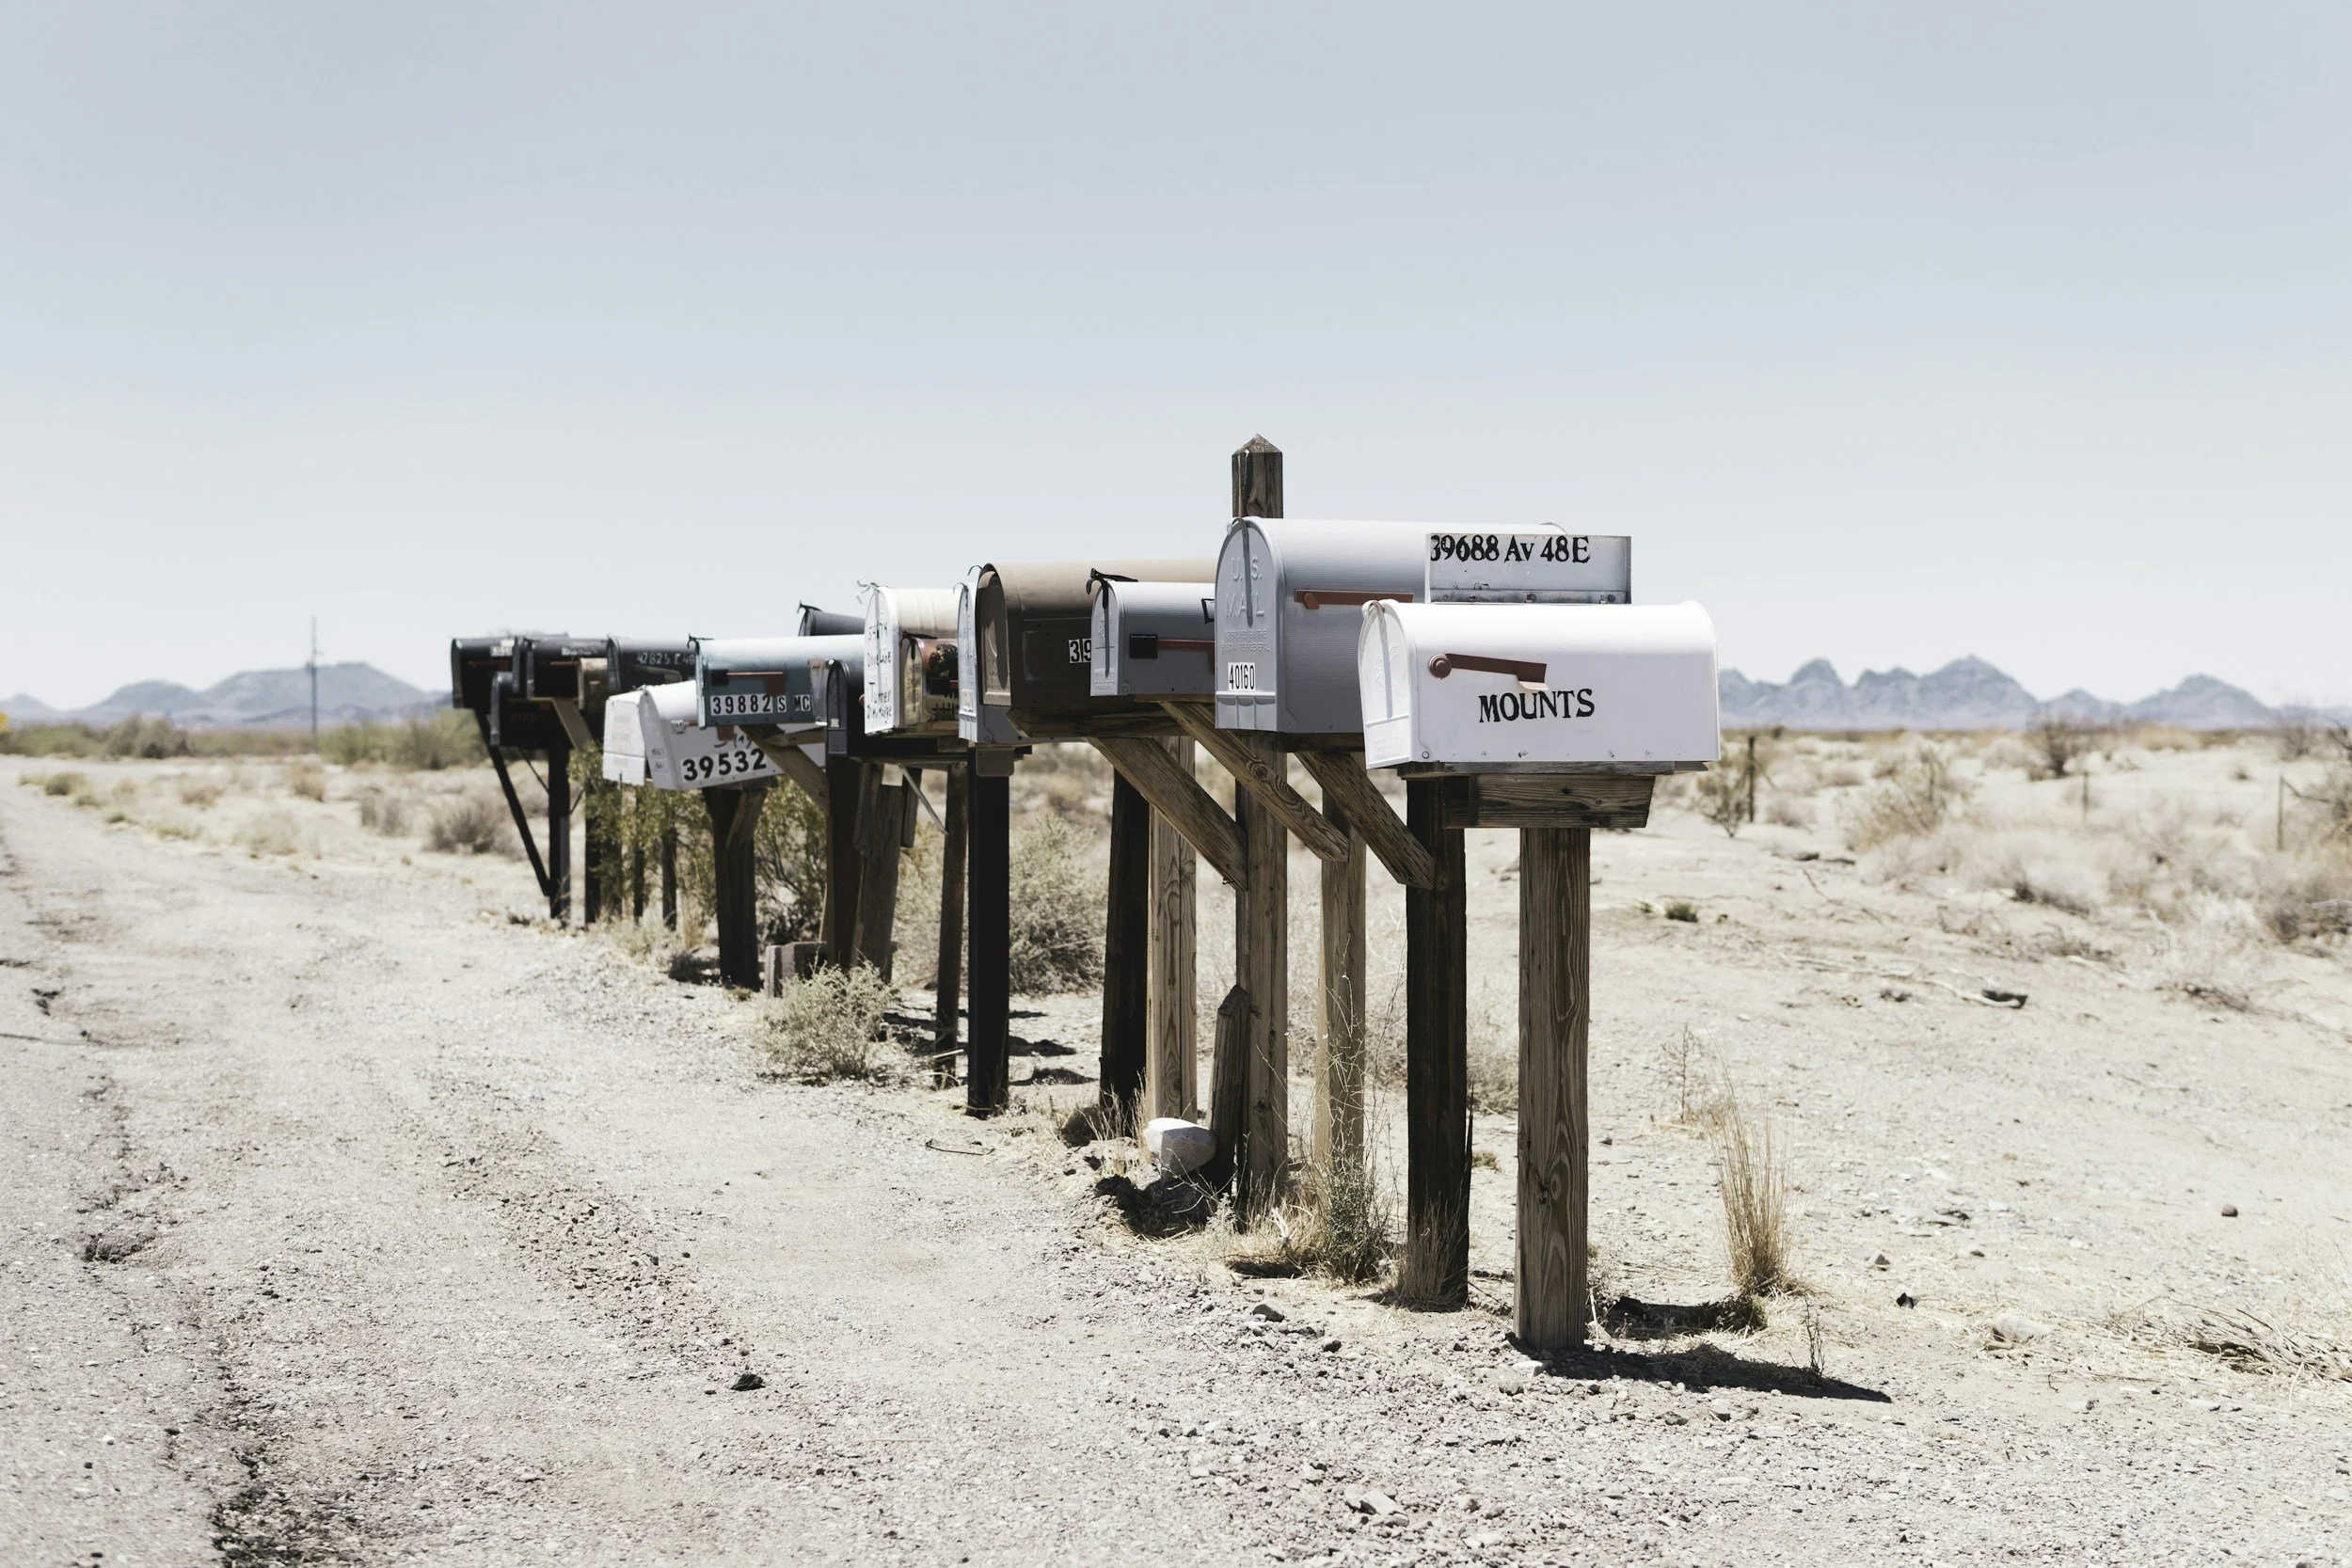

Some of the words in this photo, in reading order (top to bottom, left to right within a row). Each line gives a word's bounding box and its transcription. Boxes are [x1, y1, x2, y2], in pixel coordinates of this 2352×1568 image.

[1430, 534, 1500, 562] 39688
[1504, 535, 1534, 562] Av
[1226, 592, 1265, 617] MAL
[1229, 664, 1255, 690] 40160
[712, 695, 771, 714] 39882
[778, 696, 786, 711] S
[794, 696, 810, 711] MC
[1478, 688, 1596, 722] MOUNTS
[682, 748, 767, 781] 39532
